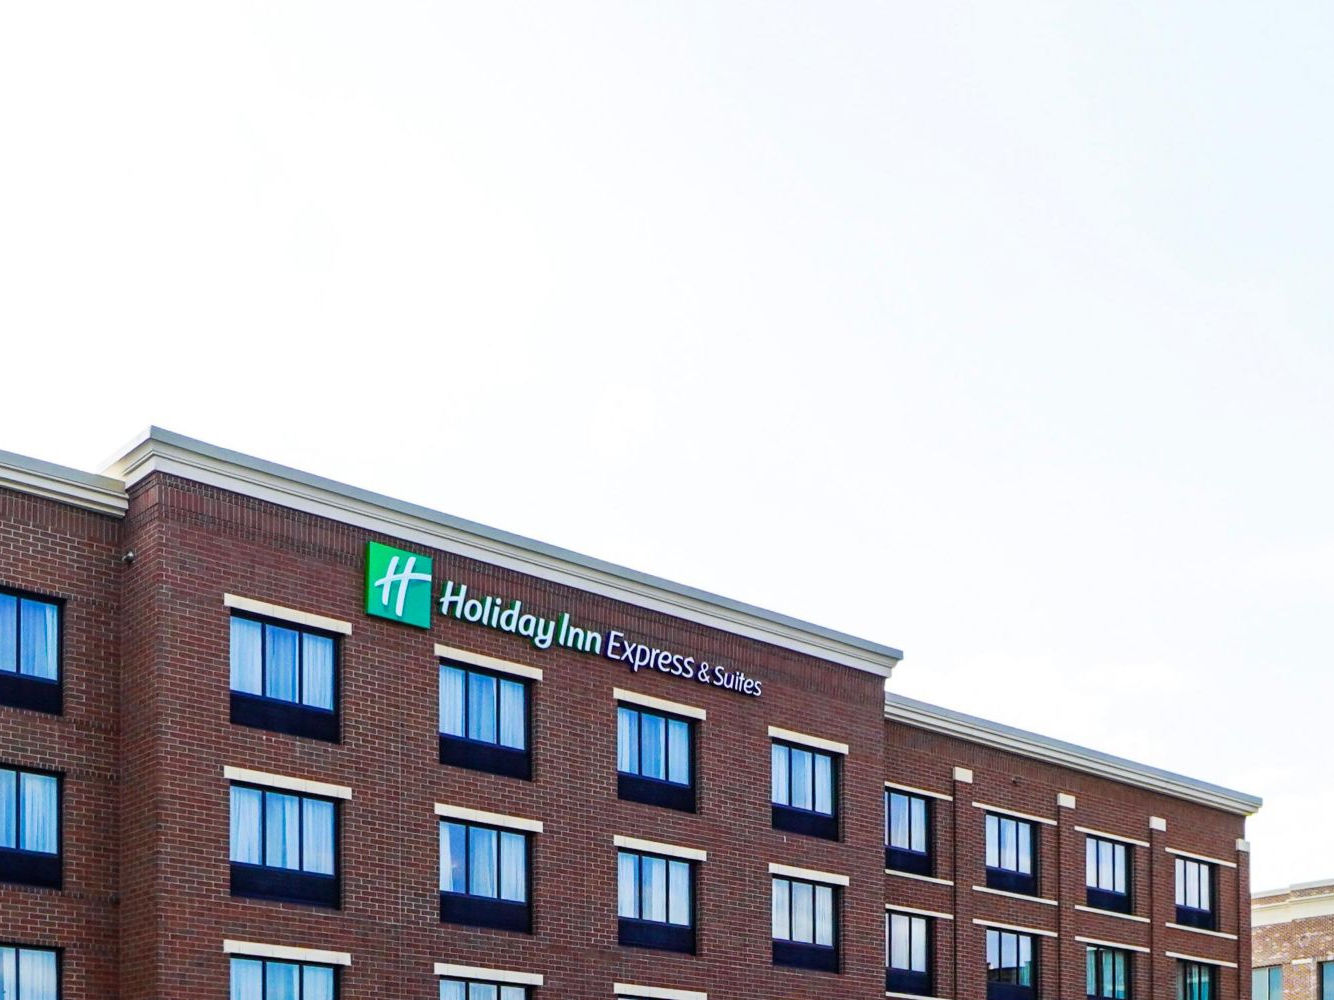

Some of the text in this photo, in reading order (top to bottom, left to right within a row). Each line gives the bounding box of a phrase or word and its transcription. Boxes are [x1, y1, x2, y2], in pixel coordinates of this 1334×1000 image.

[439, 580, 763, 697] Holiday Inn Express & Suites
